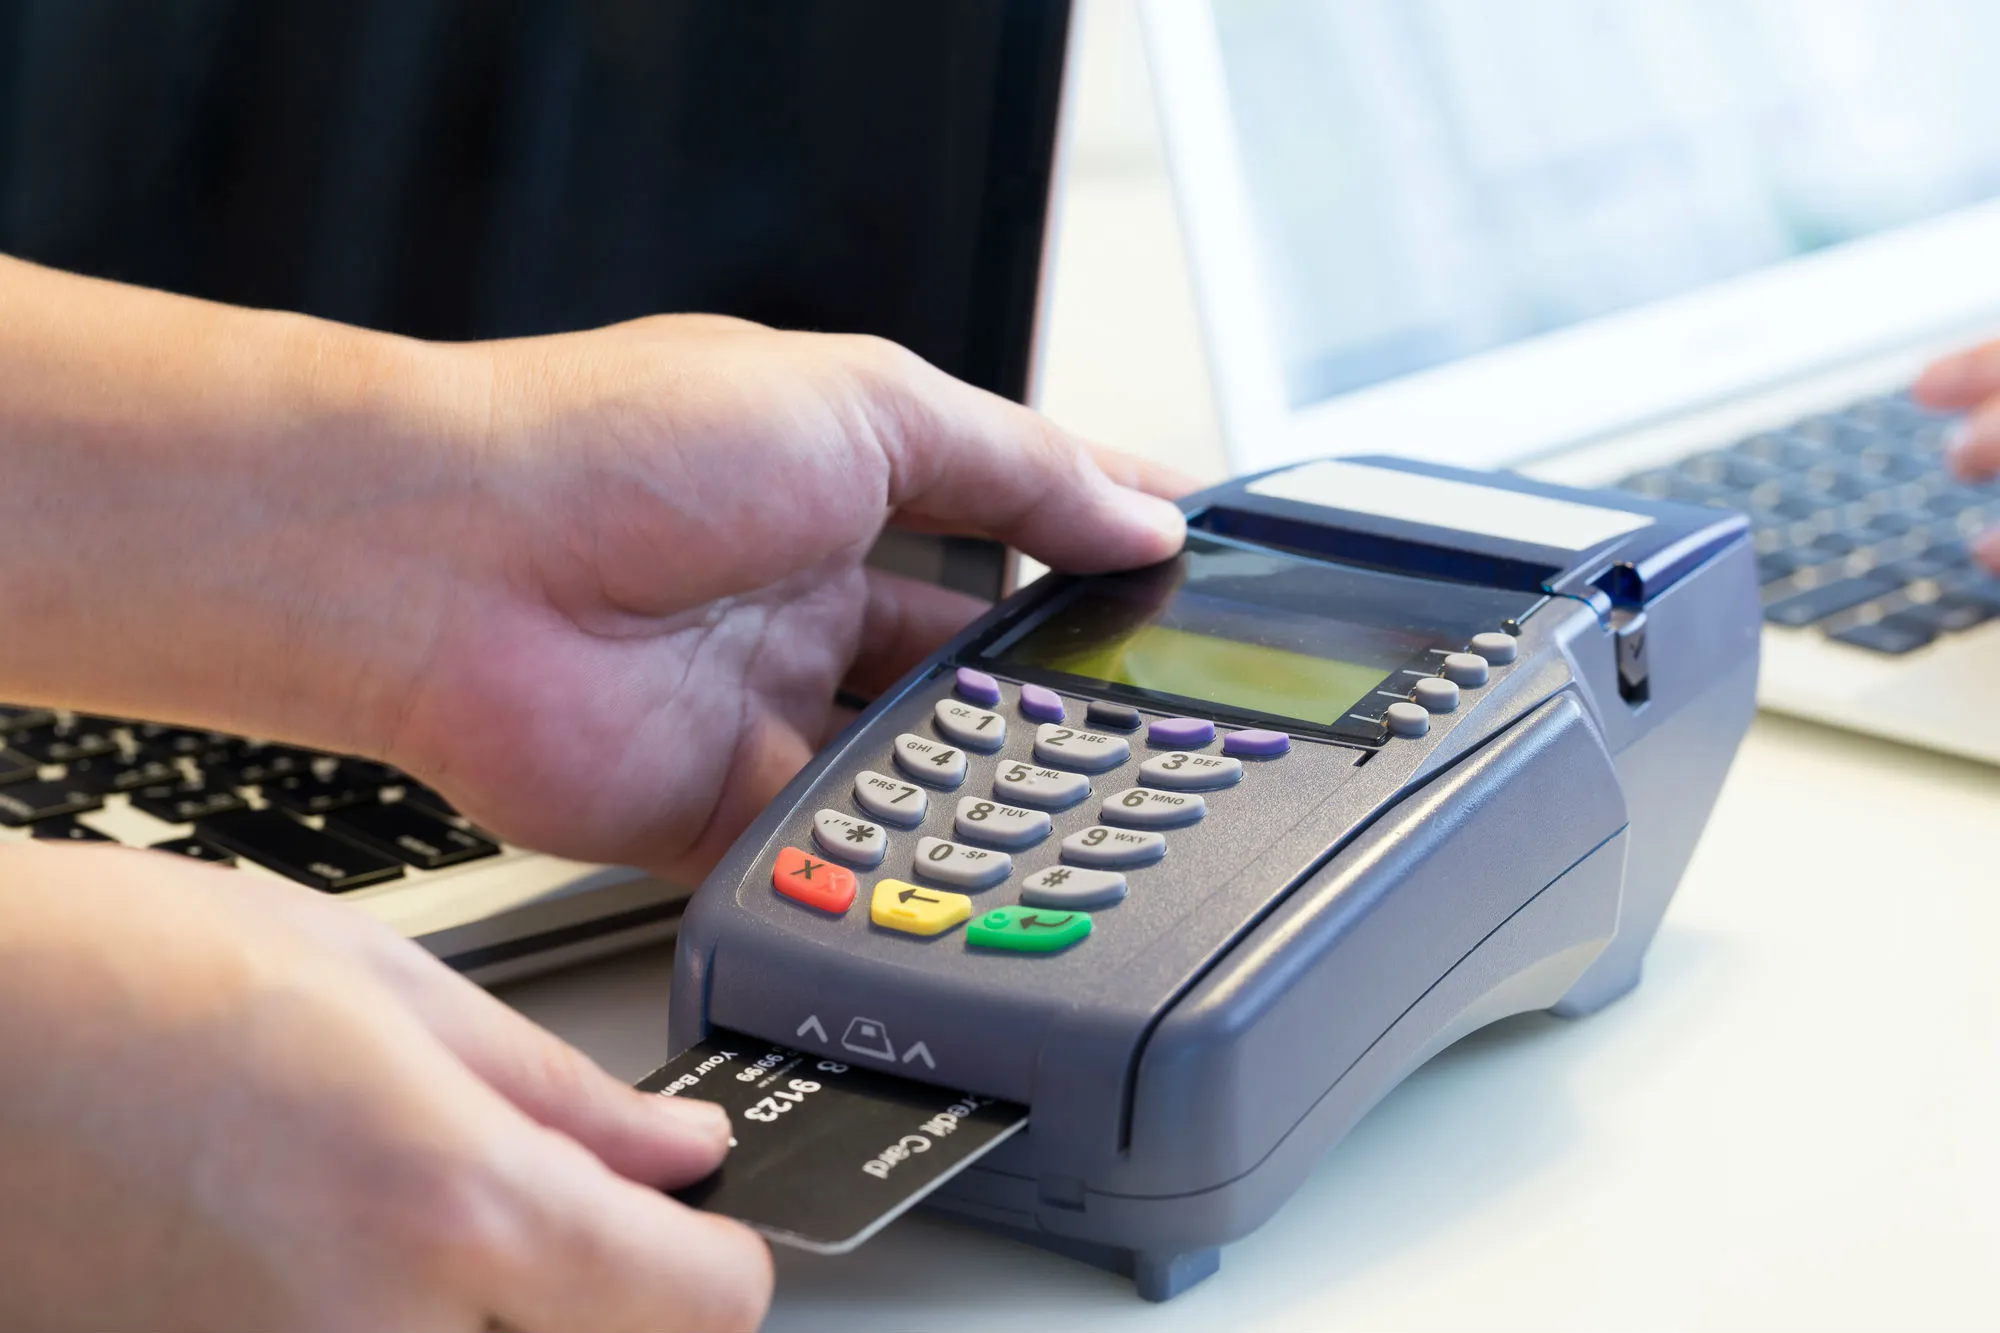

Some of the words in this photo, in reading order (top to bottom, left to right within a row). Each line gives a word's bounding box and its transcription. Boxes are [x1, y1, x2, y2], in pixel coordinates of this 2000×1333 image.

[975, 715, 996, 731] 1
[1044, 729, 1075, 747] 2
[1076, 733, 1108, 744] ABC
[906, 741, 932, 753] GHI
[930, 750, 957, 766] 4
[1161, 753, 1189, 770] 3
[1192, 757, 1223, 768] DEF
[1004, 764, 1033, 783] 5
[1035, 769, 1060, 780] JKL
[867, 777, 897, 791] PRS
[890, 787, 918, 804] 7
[1121, 790, 1150, 808] 6
[1150, 794, 1185, 806] MNO
[966, 802, 996, 821] 8
[998, 807, 1030, 818] TUV
[1081, 828, 1109, 847] 9
[1113, 832, 1149, 844] WXY
[928, 843, 954, 862] 0
[699, 1050, 739, 1077] Your
[735, 1052, 785, 1083] 99/99
[660, 1072, 700, 1097] Ban
[743, 1078, 822, 1123] 9123
[918, 1097, 982, 1138] redit
[861, 1134, 932, 1180] Card
